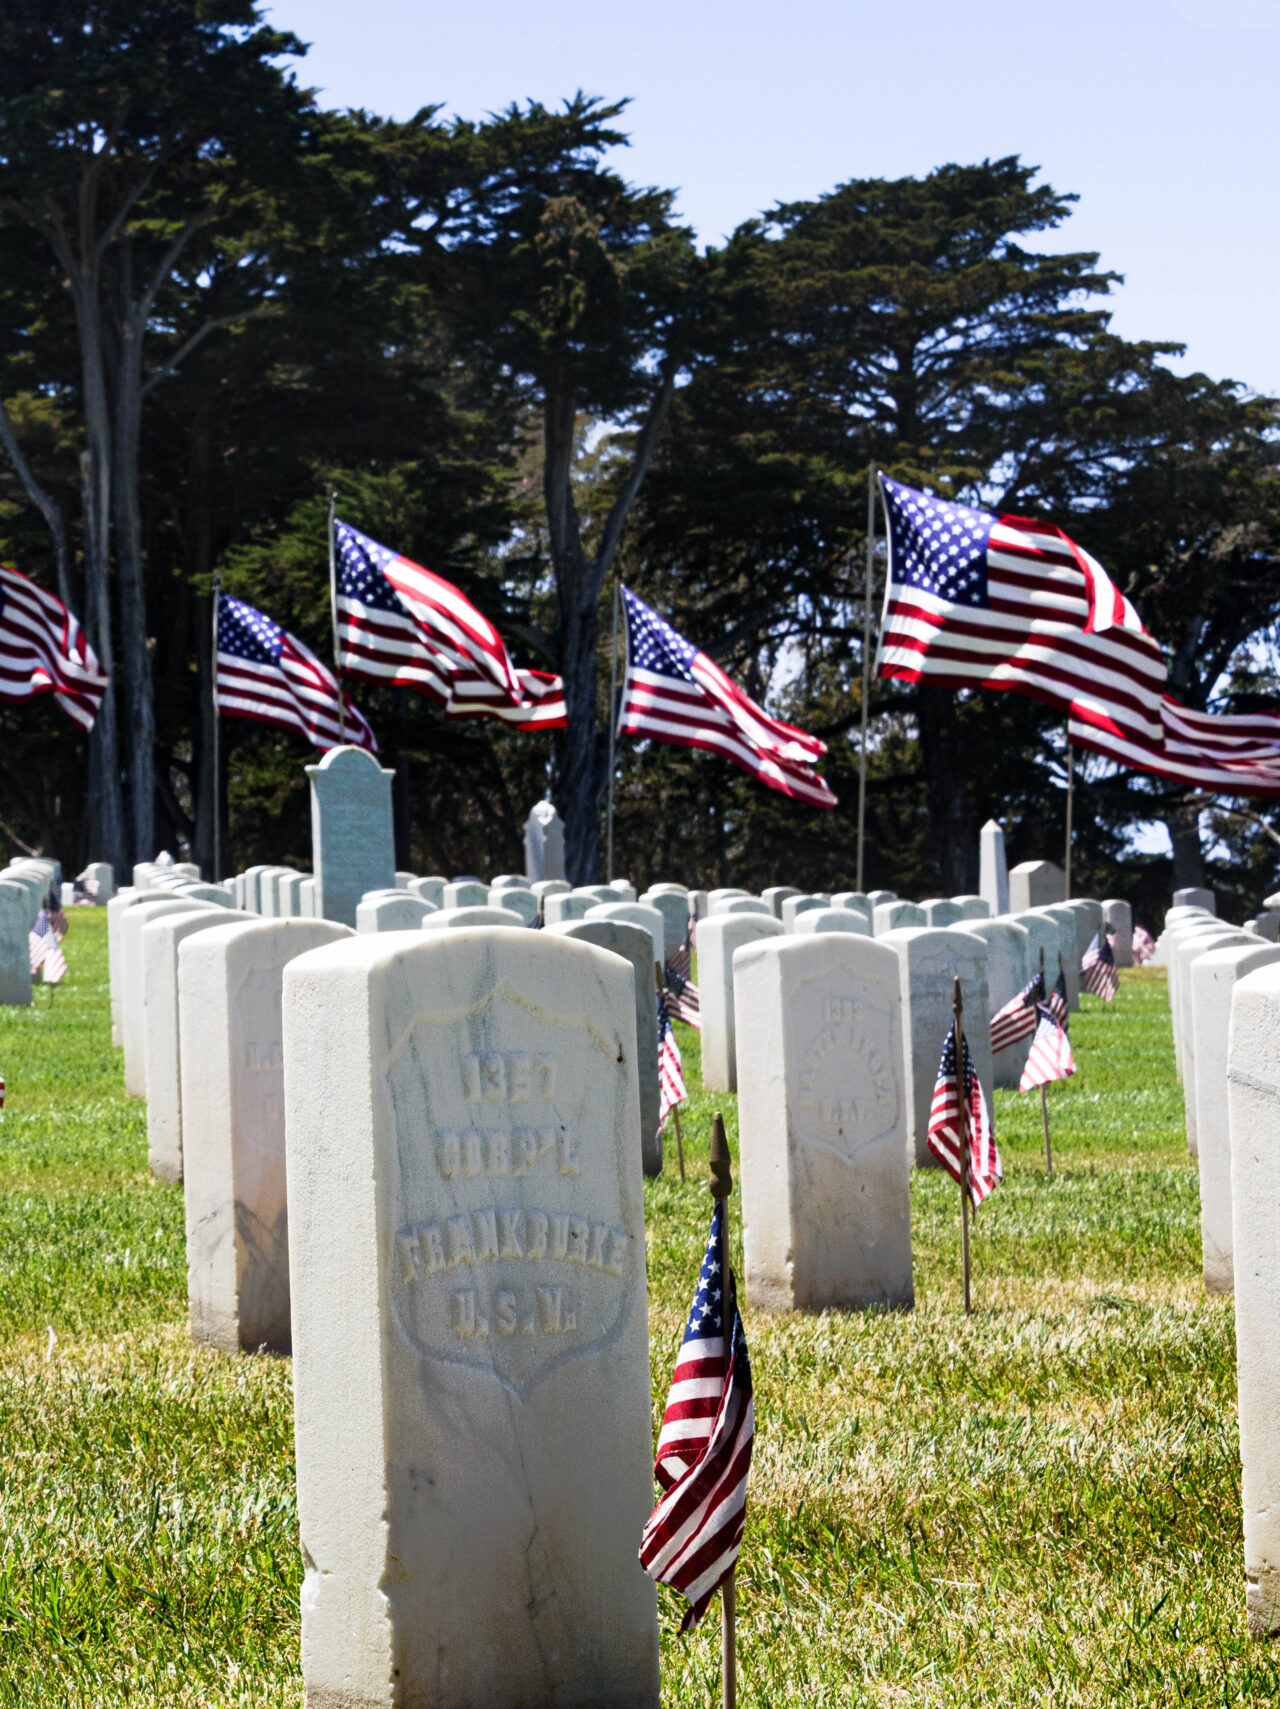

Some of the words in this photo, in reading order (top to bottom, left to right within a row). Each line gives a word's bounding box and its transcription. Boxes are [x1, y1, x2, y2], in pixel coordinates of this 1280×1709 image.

[460, 1050, 556, 1103] 1357
[393, 1206, 522, 1283] FRANK
[523, 1206, 626, 1277] BURKE
